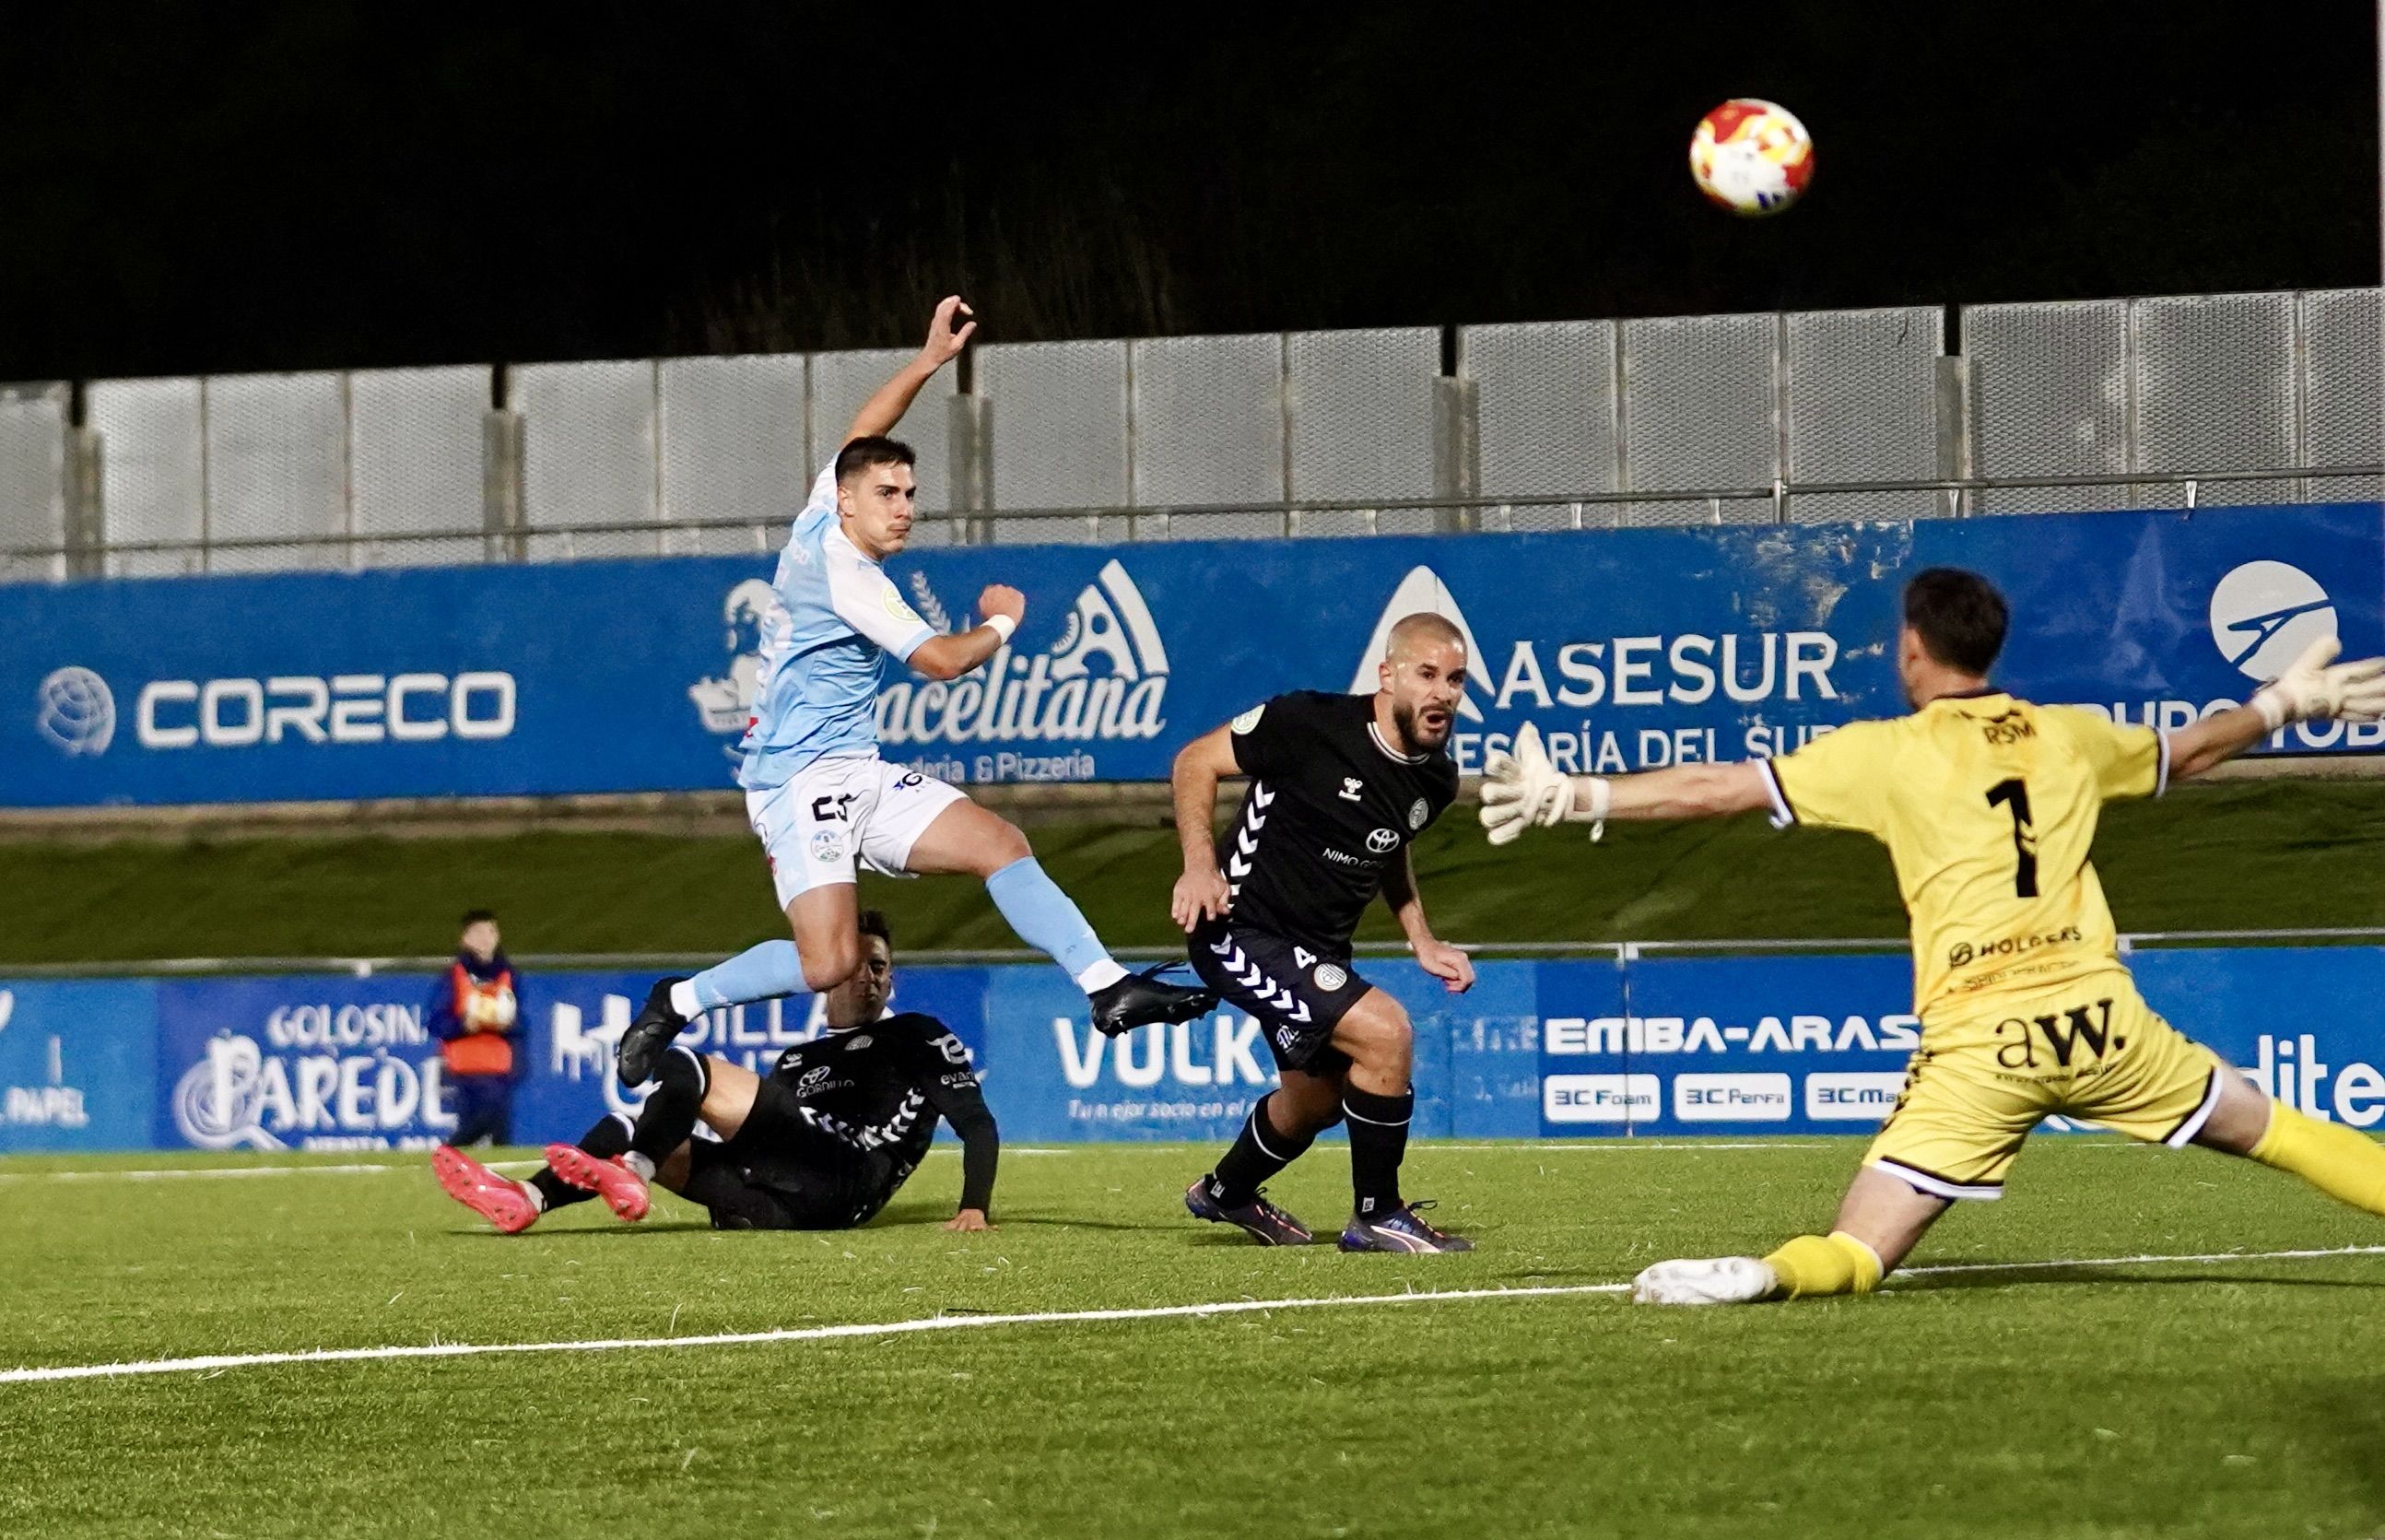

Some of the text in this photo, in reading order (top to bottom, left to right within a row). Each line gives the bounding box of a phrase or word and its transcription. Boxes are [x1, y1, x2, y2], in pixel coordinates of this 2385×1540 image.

[876, 643, 1169, 745] acelitana
[1496, 632, 1839, 710] ASESUR
[137, 671, 517, 748] CORECO
[1639, 727, 1736, 768] DEL
[1745, 724, 1838, 764] SU
[1983, 721, 2038, 745] RSM
[1986, 776, 2040, 899] 1
[1294, 946, 1318, 969] 4
[266, 1003, 429, 1049] GOLOSIN
[1051, 1013, 1282, 1089] VULK
[206, 1033, 461, 1133] PAREDE
